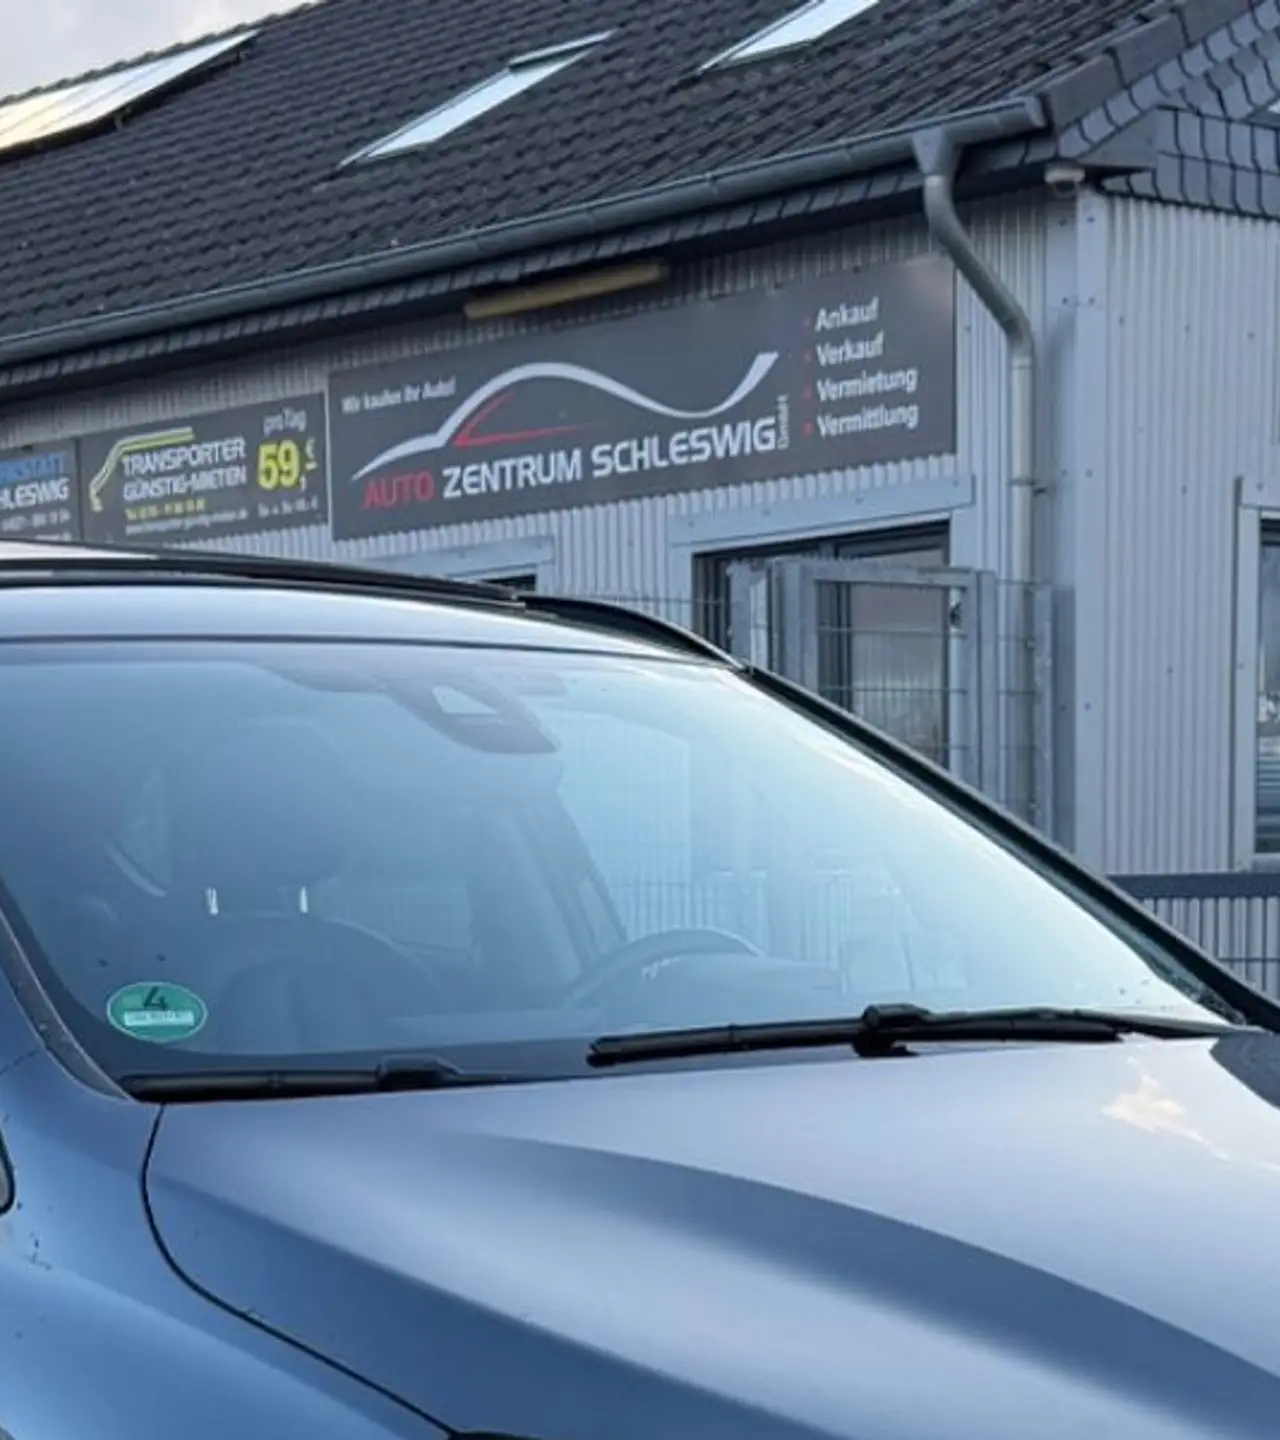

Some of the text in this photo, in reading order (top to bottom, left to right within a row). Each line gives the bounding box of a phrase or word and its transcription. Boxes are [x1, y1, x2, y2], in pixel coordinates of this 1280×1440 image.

[815, 296, 879, 332] Ankauf
[816, 328, 884, 367] Verkauf
[816, 367, 918, 402] Vermietung
[816, 403, 918, 439] Vermittlung
[123, 436, 246, 476] TRANSPORTER
[363, 470, 434, 509] AUTO
[442, 448, 582, 499] ZENTRUM
[591, 416, 776, 478] SCHLESWIG
[143, 986, 167, 1011] 4
